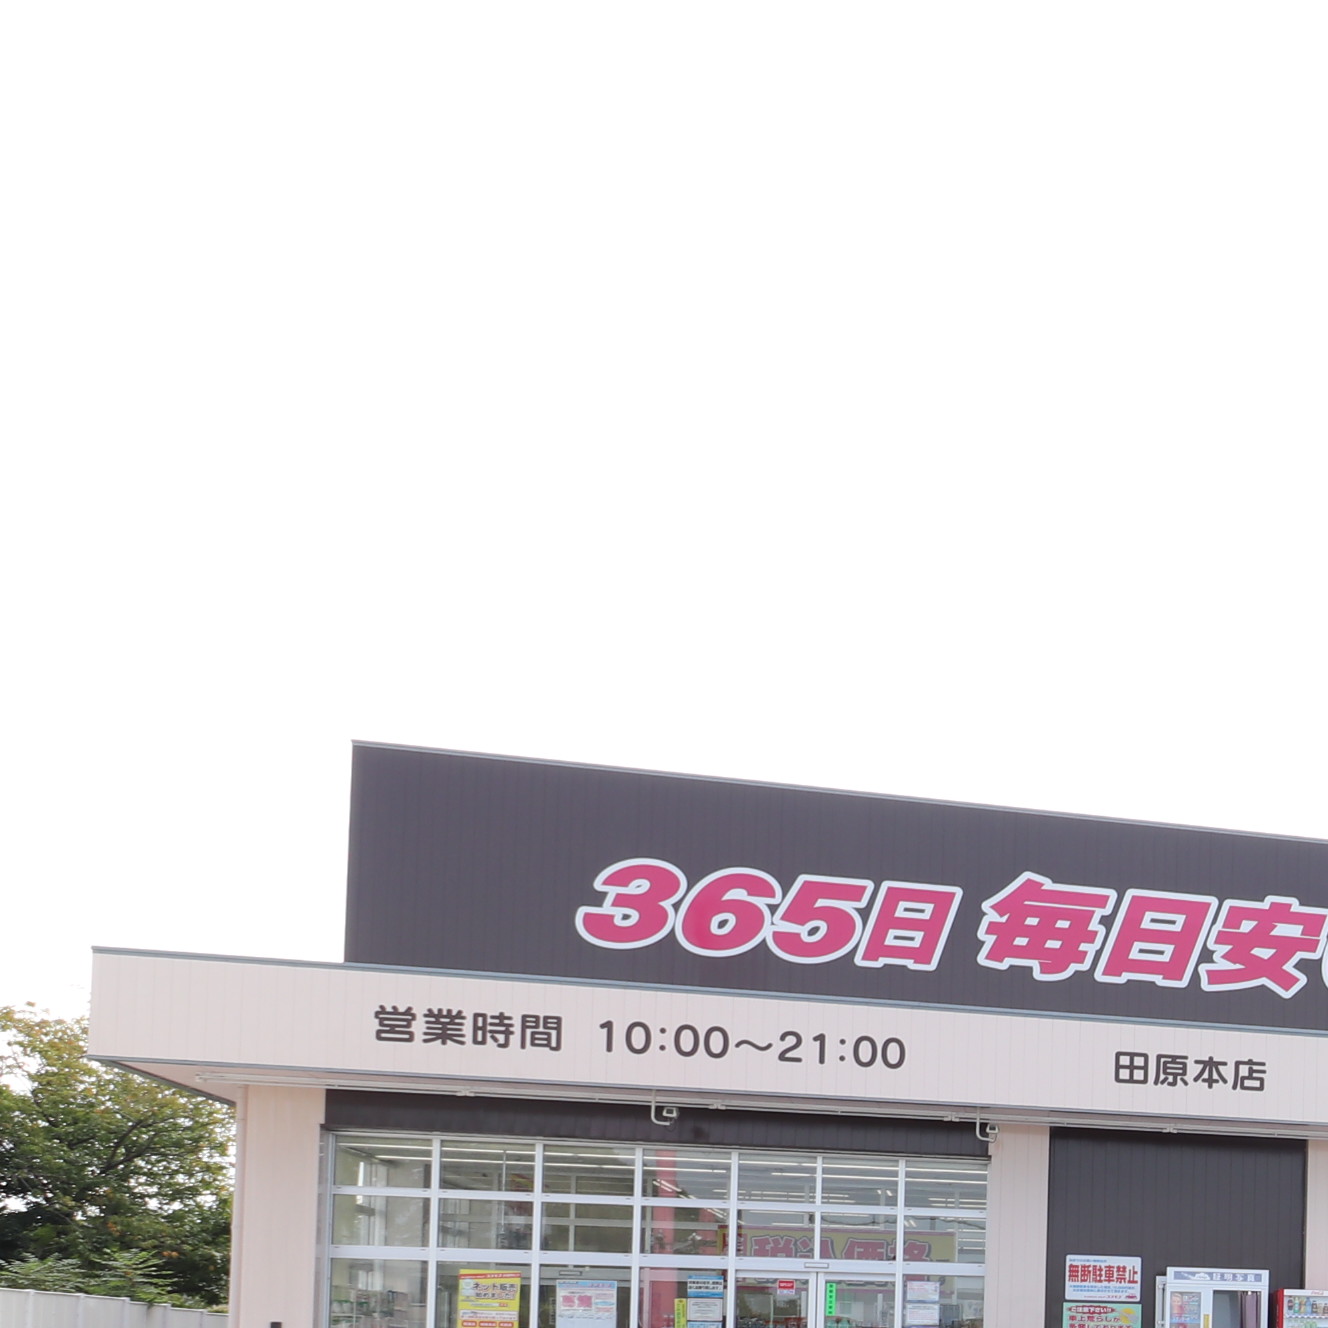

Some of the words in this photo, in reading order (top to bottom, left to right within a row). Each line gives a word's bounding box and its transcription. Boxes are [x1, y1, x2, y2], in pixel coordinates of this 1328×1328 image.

[575, 858, 963, 971] 365日
[373, 1005, 563, 1052] 営業時間
[1113, 1051, 1267, 1092] 田原本店
[1068, 1263, 1138, 1284] 無断駐車禁止
[1212, 1272, 1256, 1282] 証明写真
